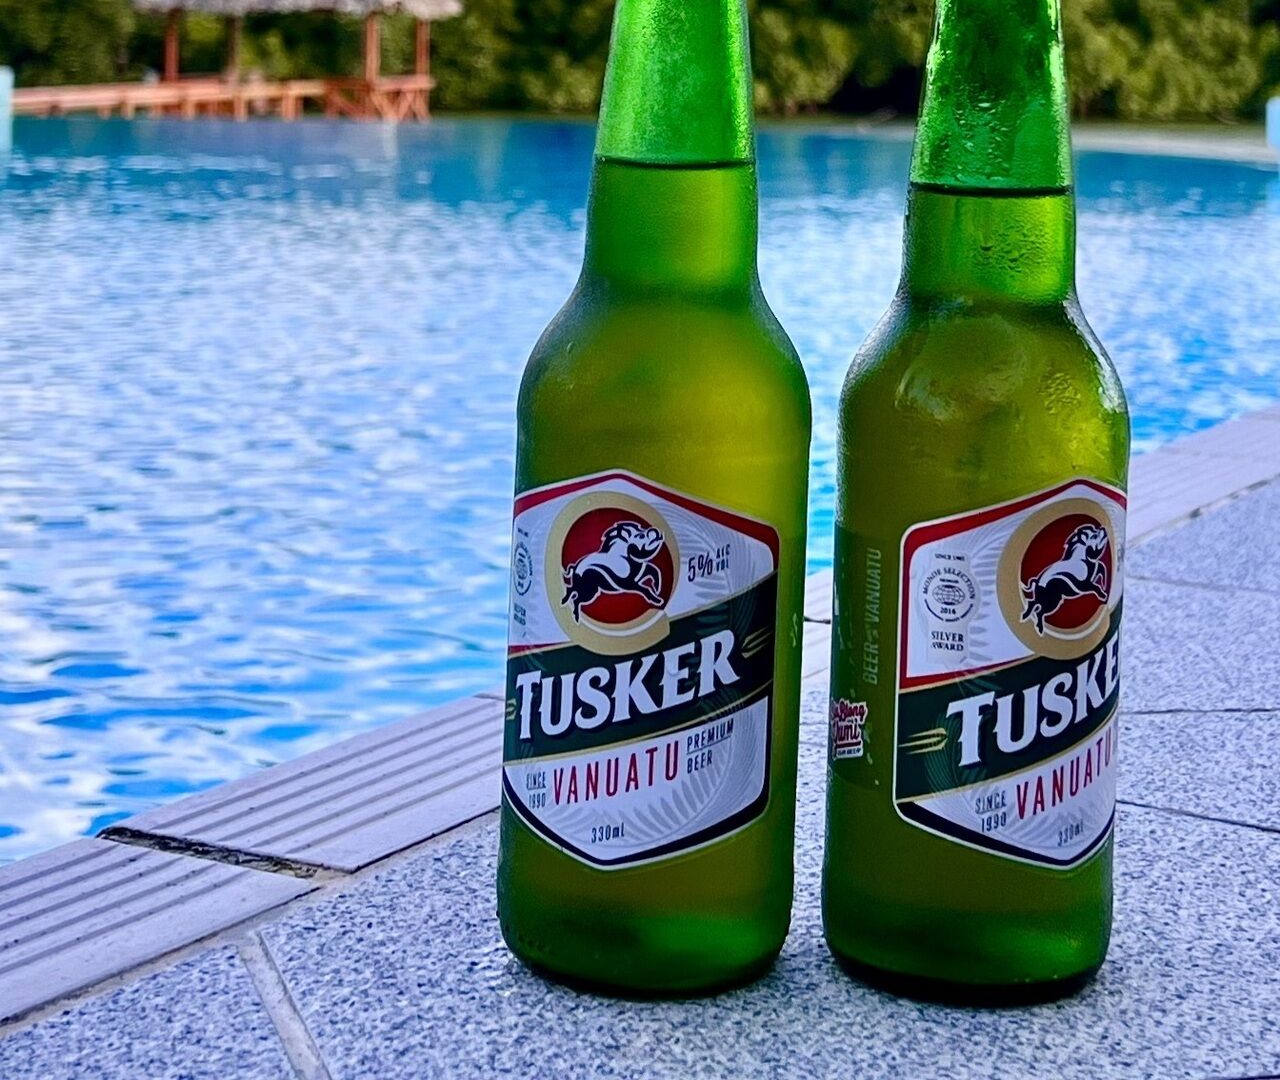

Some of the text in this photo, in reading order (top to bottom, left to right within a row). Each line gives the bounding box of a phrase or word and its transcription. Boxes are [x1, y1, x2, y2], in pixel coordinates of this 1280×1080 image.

[688, 551, 713, 583] 5%
[864, 548, 882, 623] VANUATU
[931, 631, 964, 642] SILVER
[931, 641, 964, 652] AWARD
[863, 642, 879, 685] BEER
[516, 629, 741, 739] TUSKER
[946, 629, 1119, 767] TUSKE
[687, 718, 734, 750] PREMIUM
[553, 740, 679, 806] VANUATU
[687, 749, 713, 774] BEER
[1016, 726, 1112, 820] VANUATU
[526, 771, 546, 789] SINCE
[975, 790, 1007, 813] SINCE
[981, 811, 1007, 832] 1990
